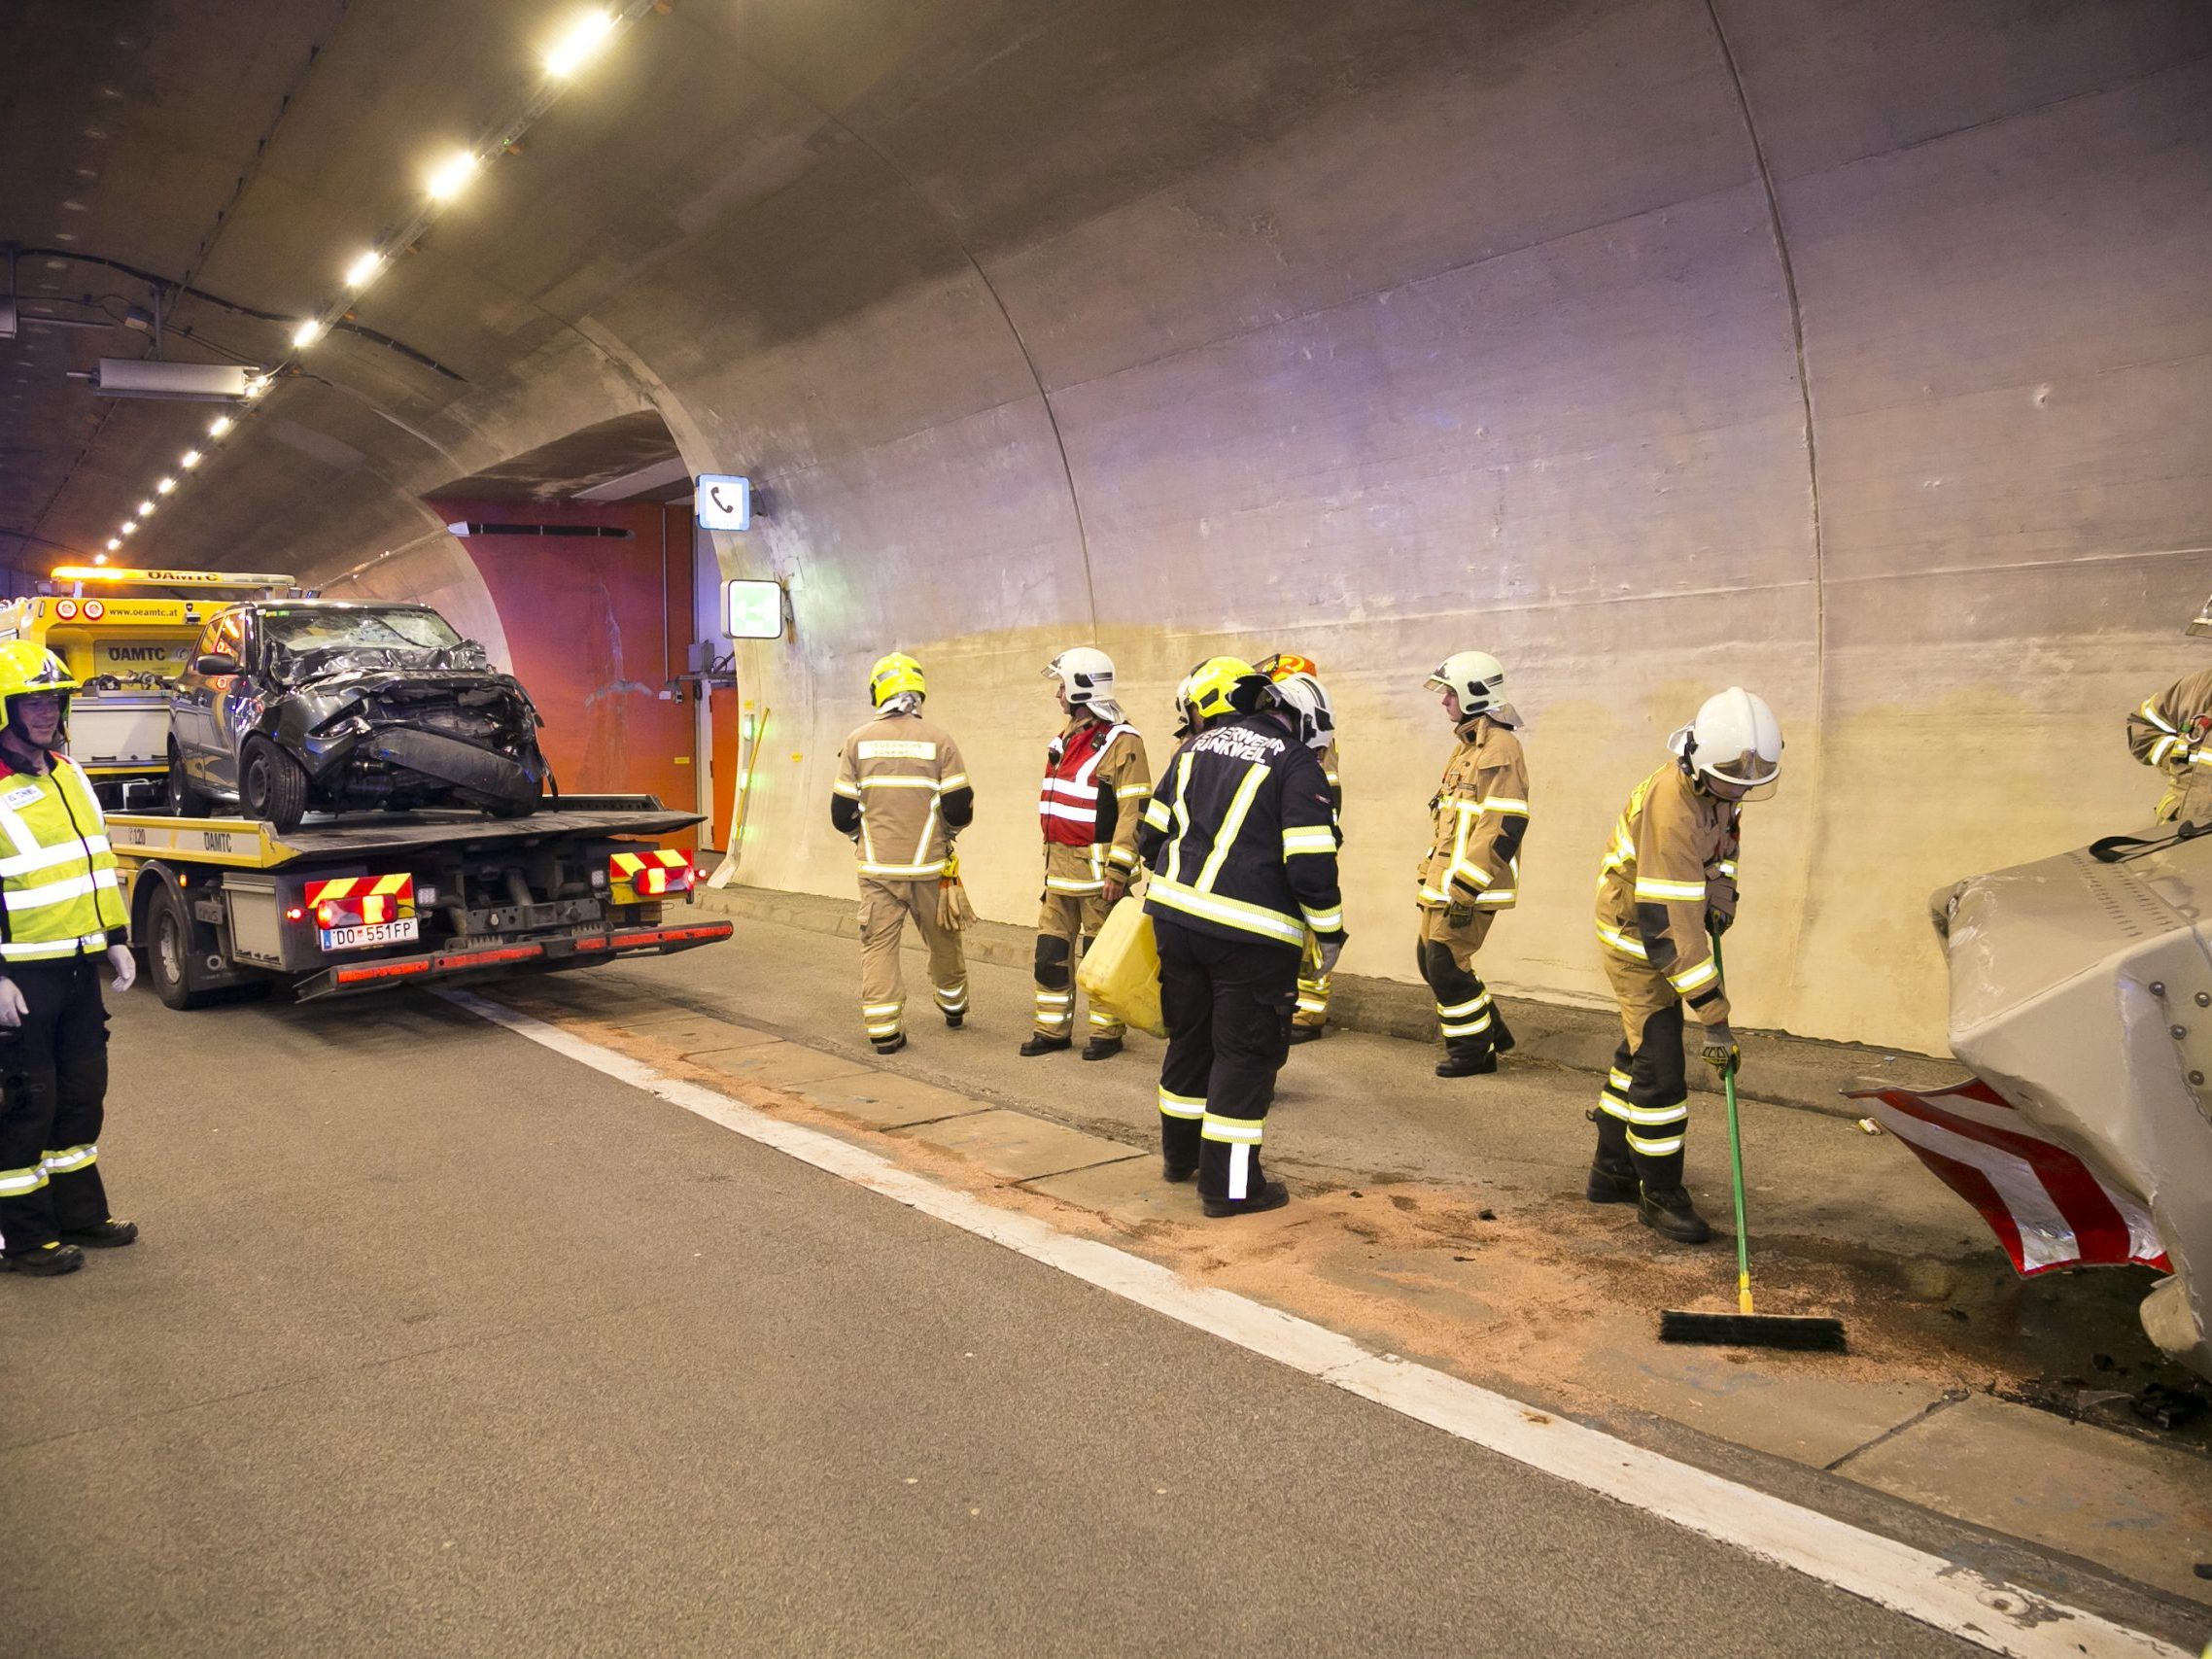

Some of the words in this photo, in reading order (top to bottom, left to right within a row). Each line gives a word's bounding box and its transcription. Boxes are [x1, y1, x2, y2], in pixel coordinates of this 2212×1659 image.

[109, 607, 178, 618] www.oeamtc.at
[109, 646, 165, 661] ÖAMTC
[337, 929, 355, 946] DO
